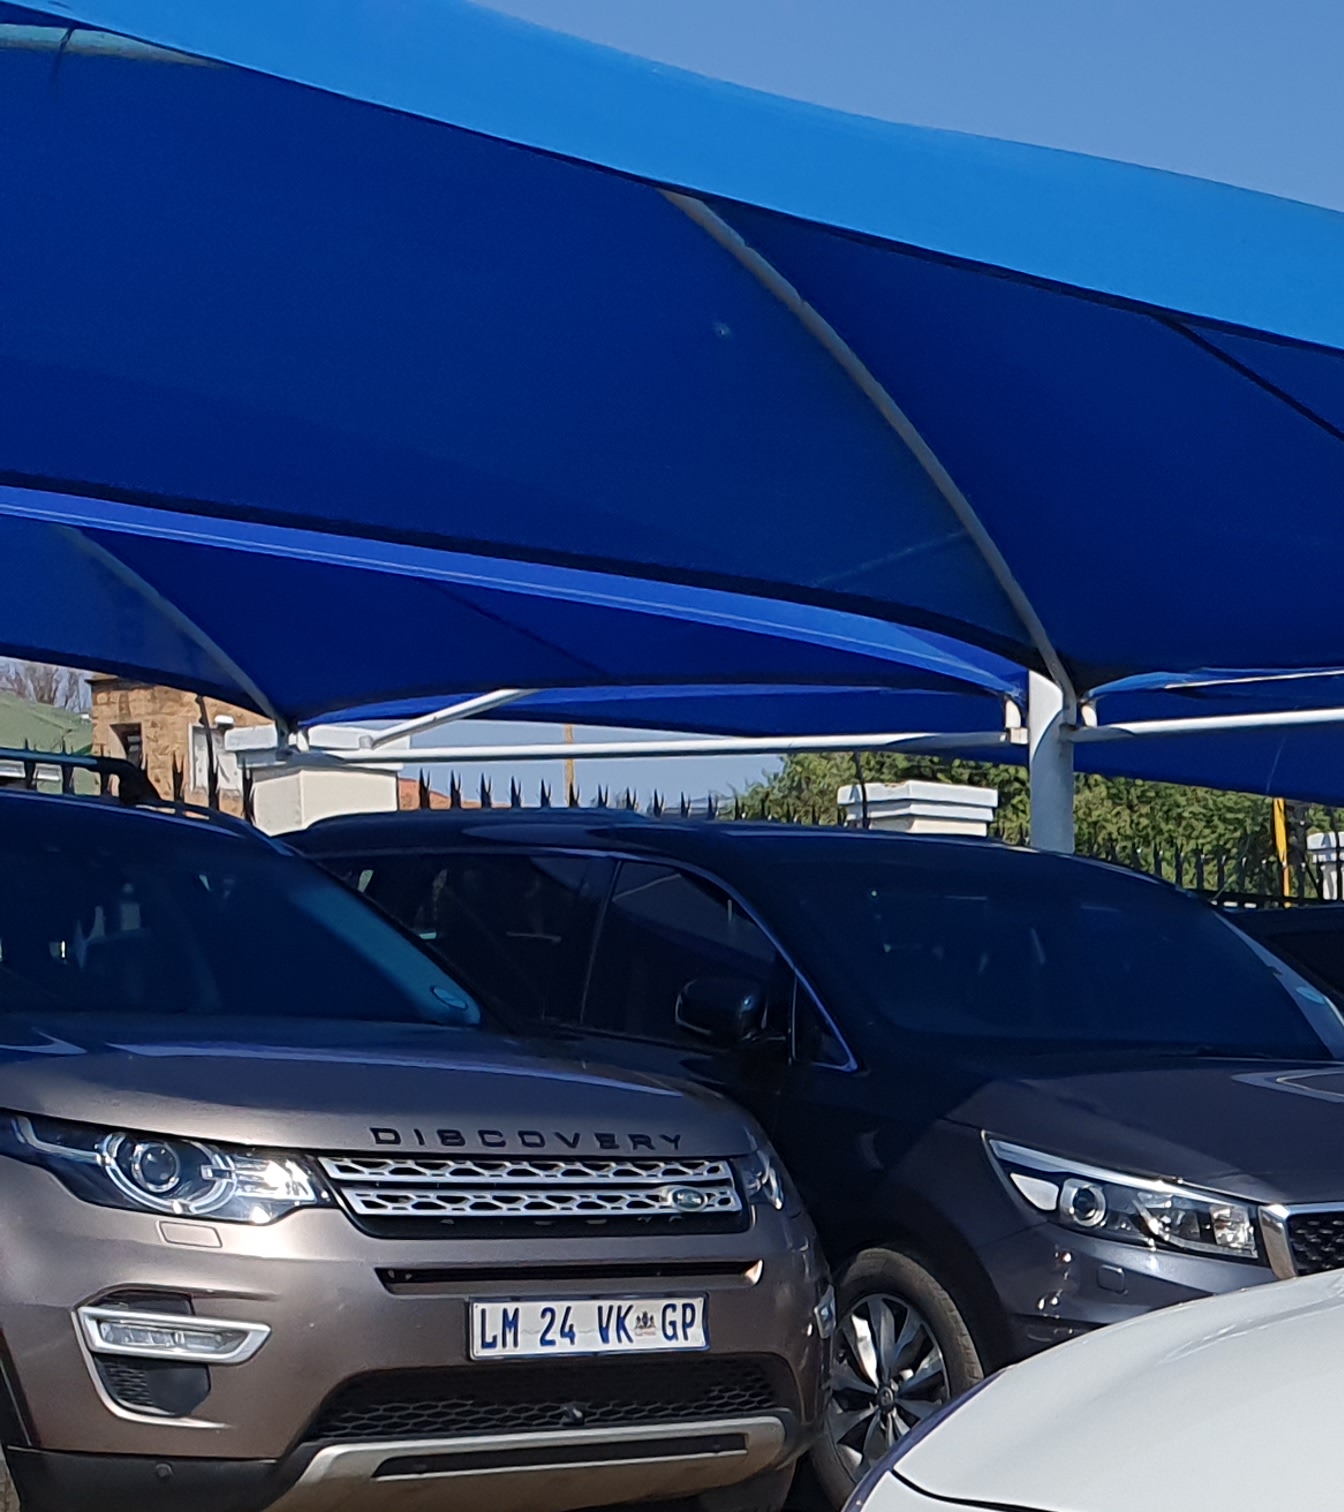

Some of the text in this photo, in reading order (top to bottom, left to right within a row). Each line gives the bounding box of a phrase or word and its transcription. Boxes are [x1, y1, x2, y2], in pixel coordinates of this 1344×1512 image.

[369, 1126, 682, 1151] DISCOVERY
[480, 1302, 697, 1350] LM 24 VK GP
